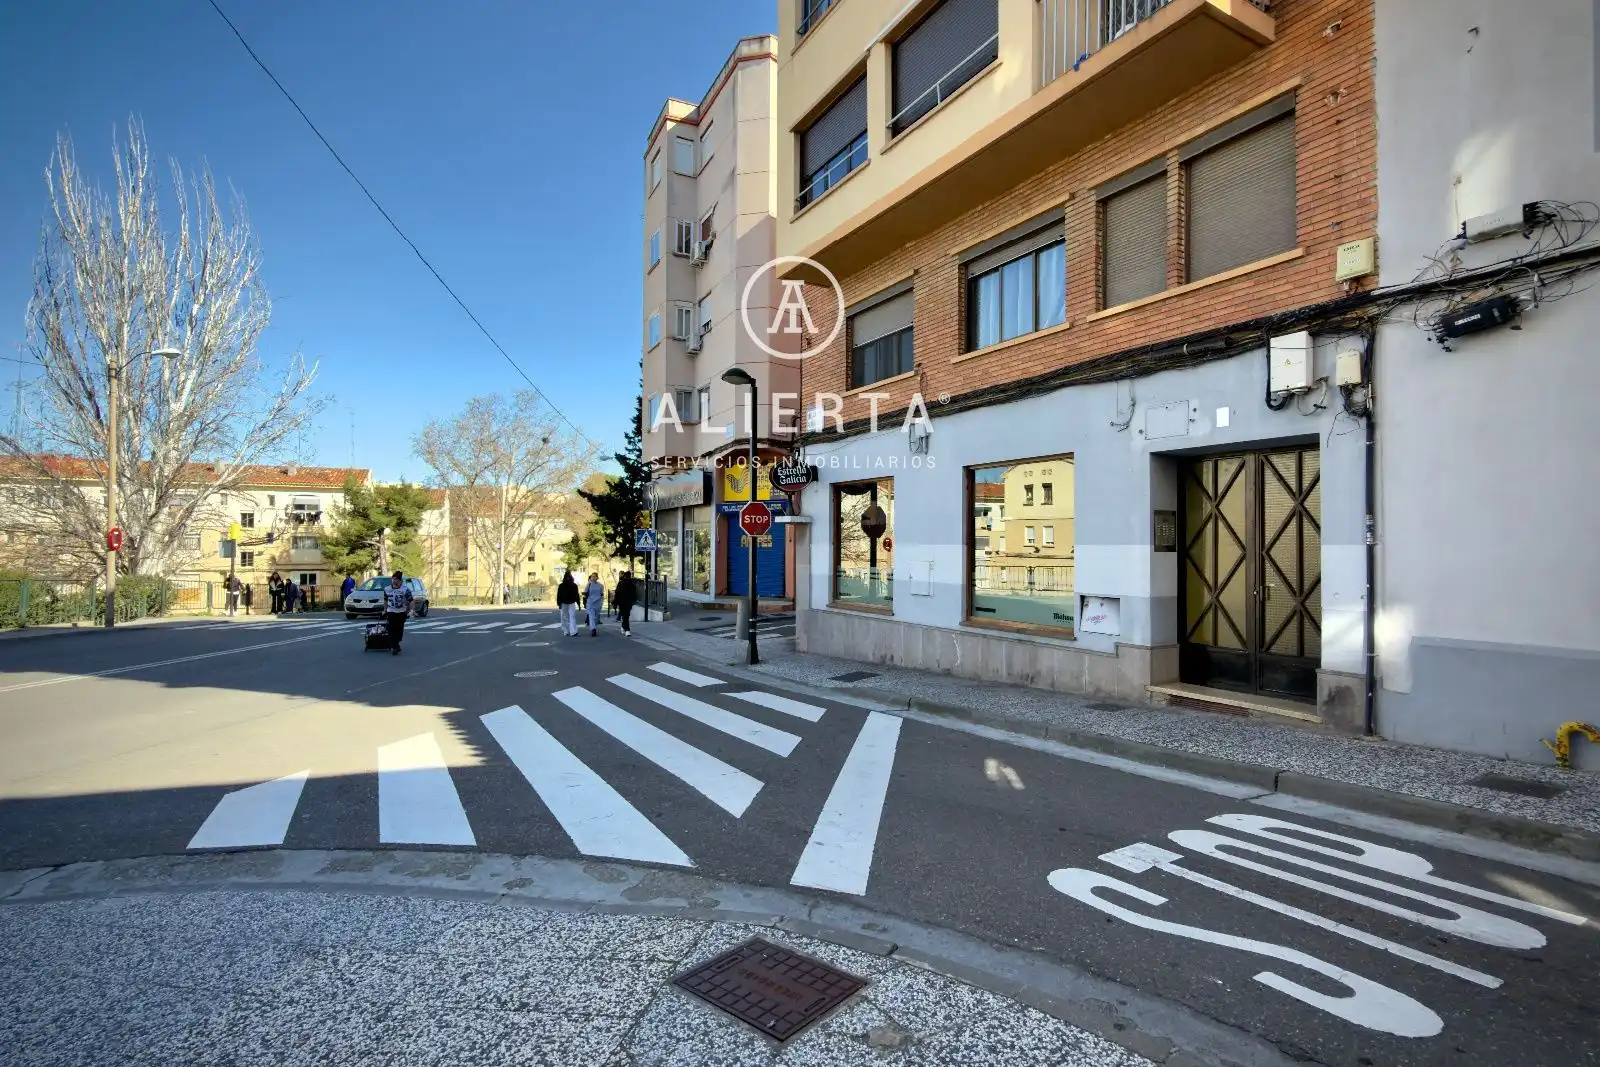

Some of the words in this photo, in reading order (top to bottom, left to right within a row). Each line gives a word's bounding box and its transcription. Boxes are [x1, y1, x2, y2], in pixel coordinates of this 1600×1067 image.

[777, 465, 807, 476] Estrella
[779, 474, 807, 485] Galicia
[744, 515, 769, 524] STOP
[1053, 612, 1074, 621] Mahou
[1046, 813, 1589, 1038] STOP
